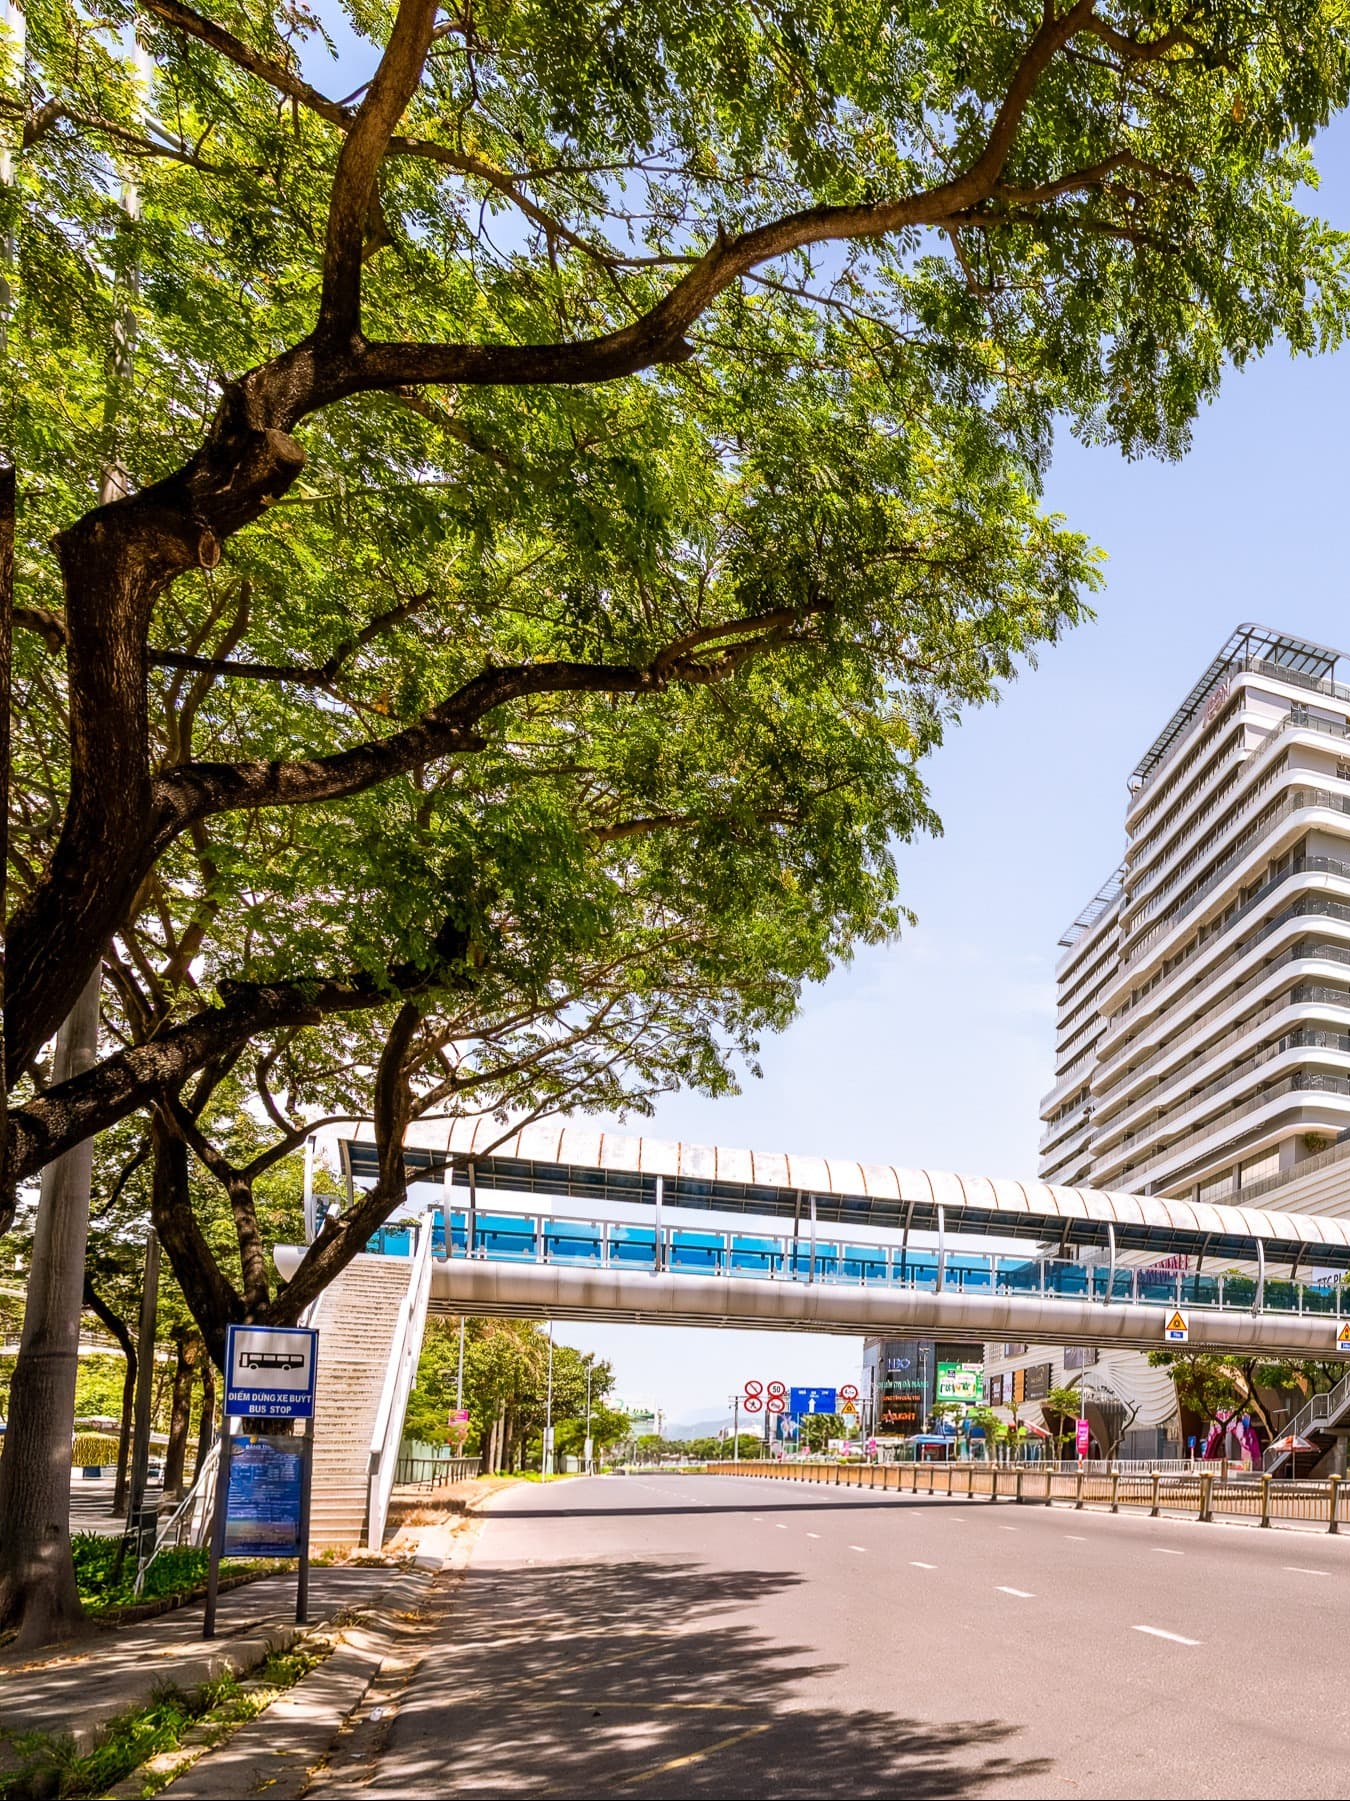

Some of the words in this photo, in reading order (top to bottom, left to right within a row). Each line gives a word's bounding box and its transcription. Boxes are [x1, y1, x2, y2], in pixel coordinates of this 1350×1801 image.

[276, 1394, 288, 1402] XE
[249, 1405, 266, 1413] BUS
[270, 1405, 292, 1414] STOP
